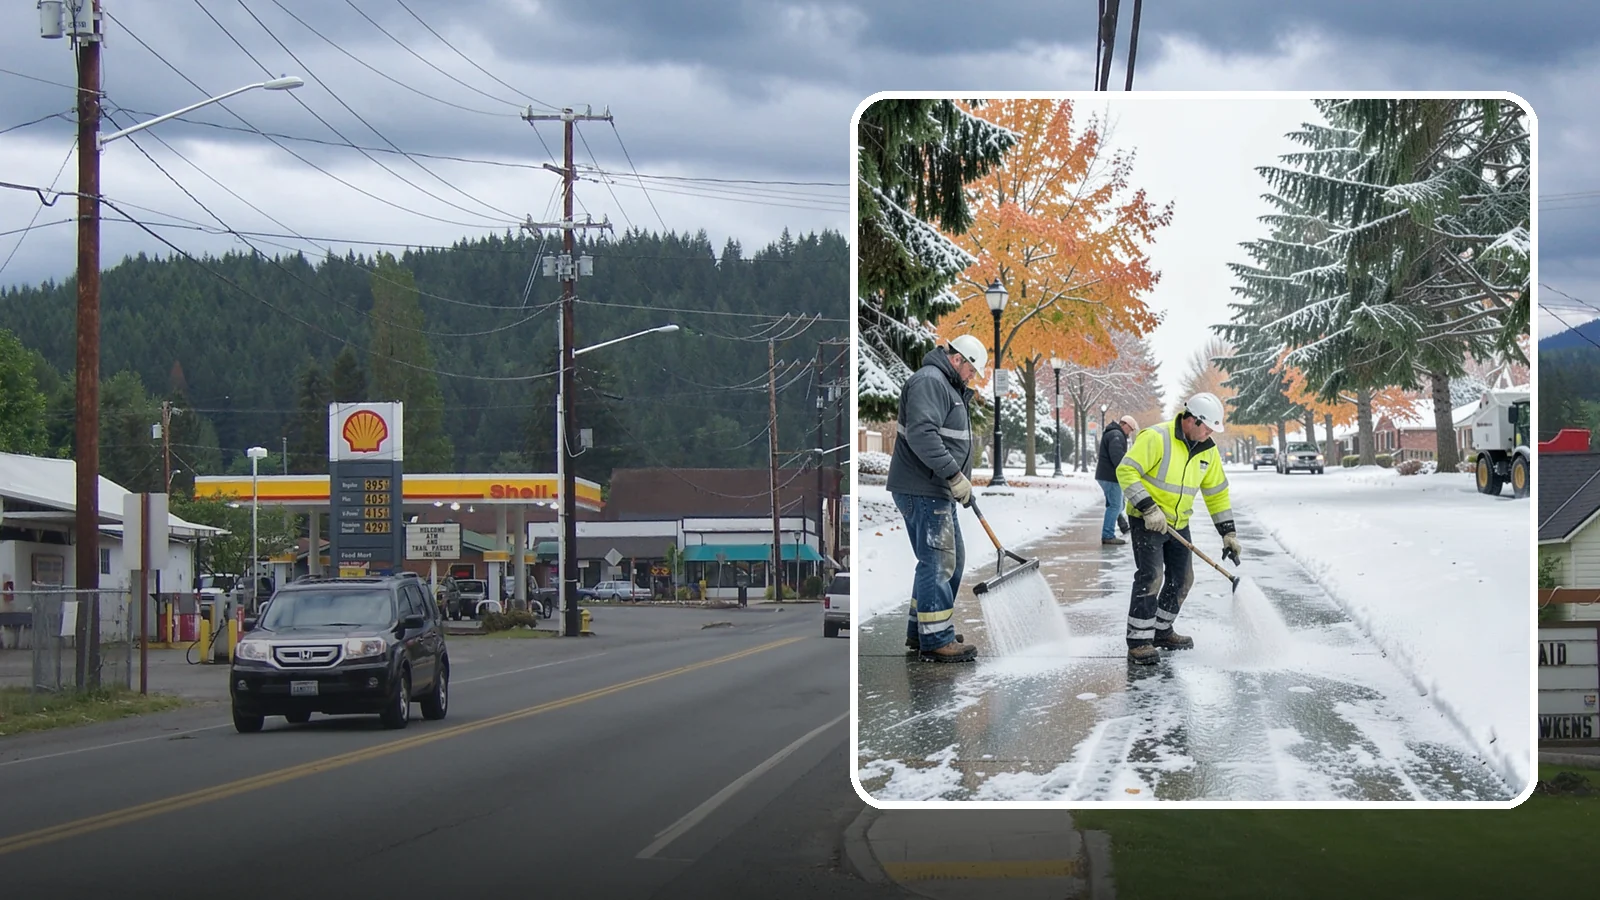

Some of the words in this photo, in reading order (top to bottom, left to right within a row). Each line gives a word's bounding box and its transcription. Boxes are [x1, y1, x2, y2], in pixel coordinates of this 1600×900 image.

[366, 480, 384, 490] 395
[490, 484, 547, 499] Shell
[365, 494, 384, 504] 405
[365, 508, 384, 518] 415
[366, 522, 384, 532] 429
[1538, 716, 1592, 739] WKENS
